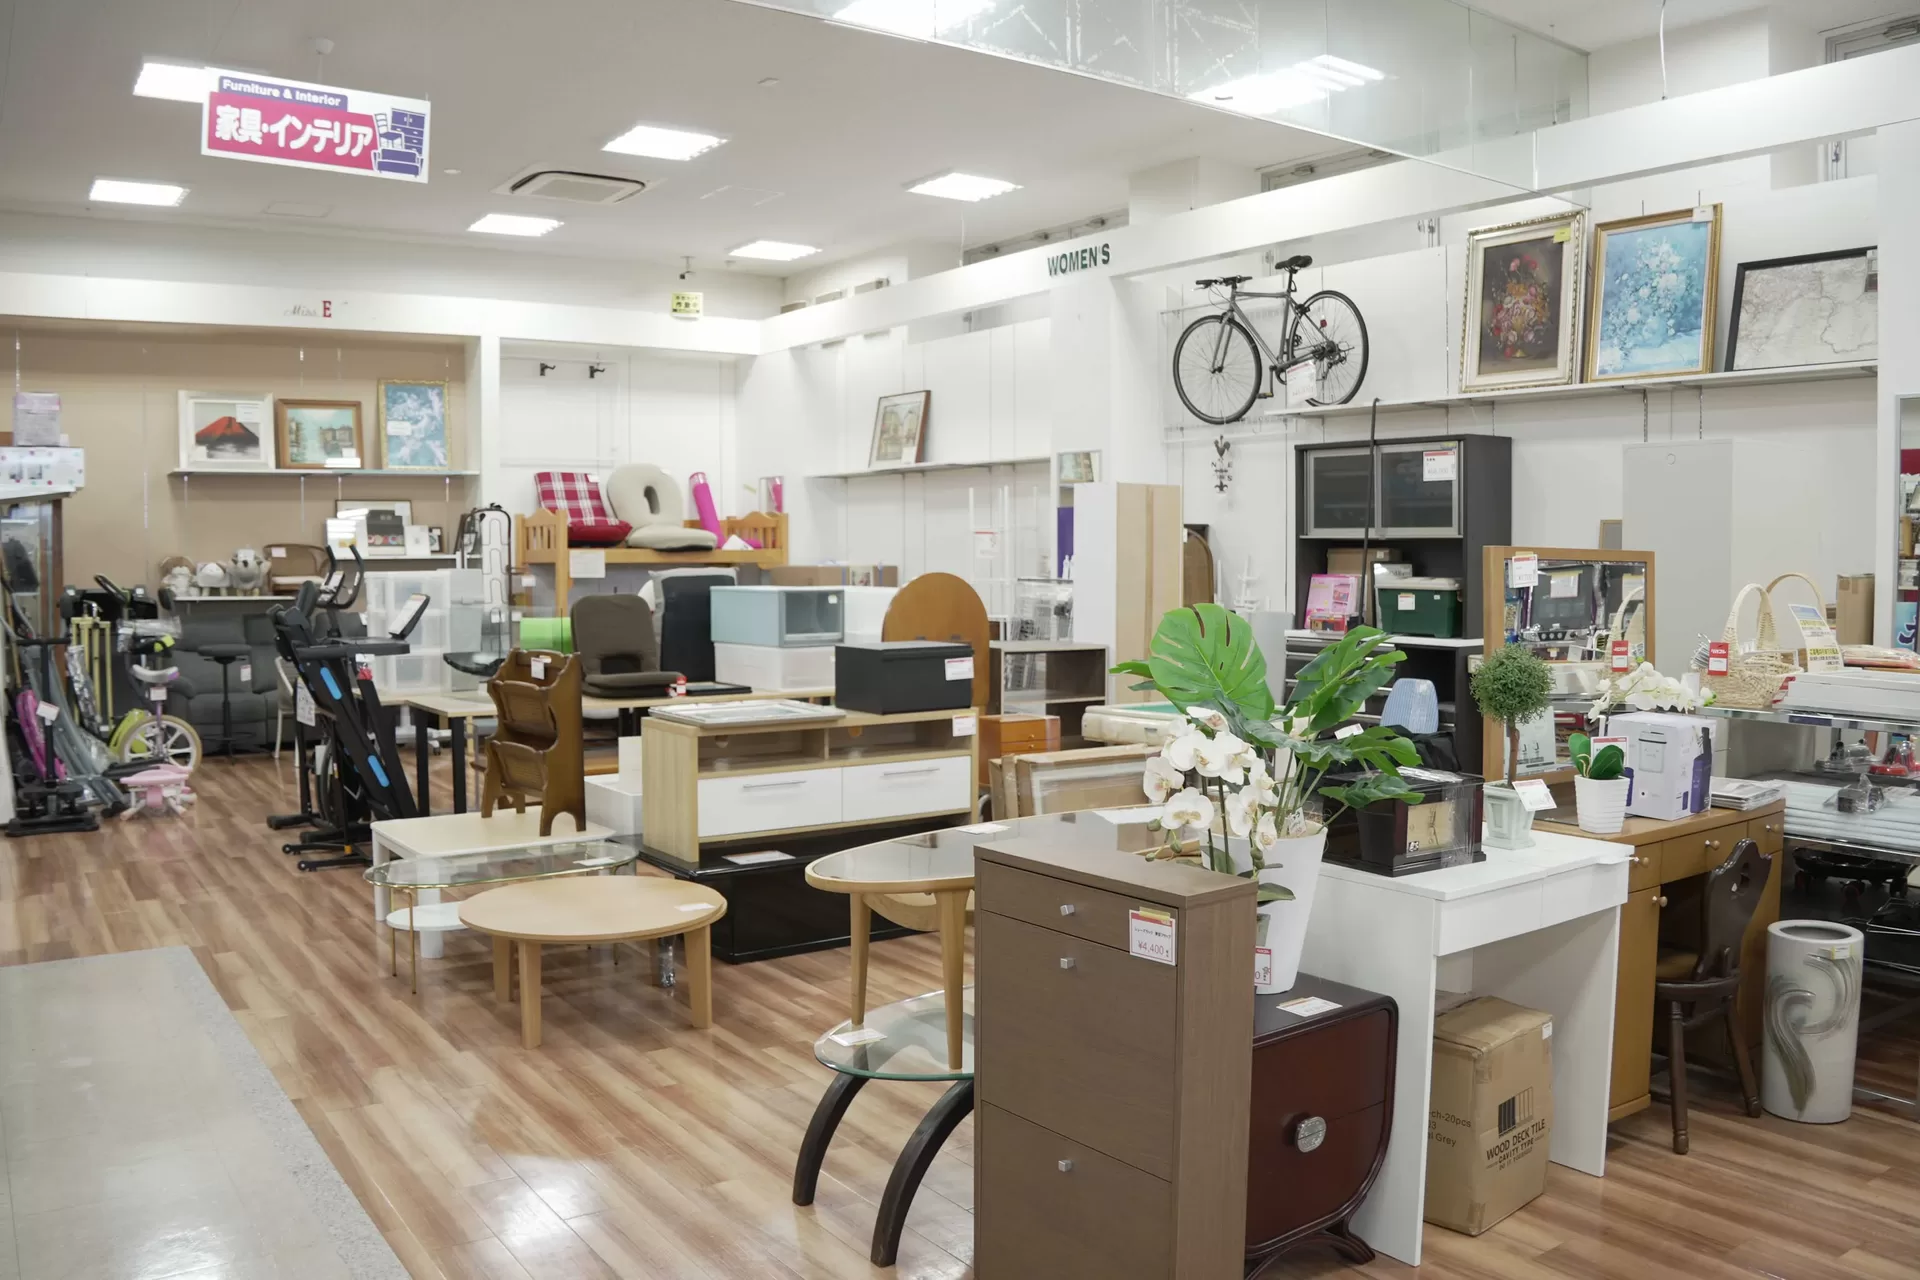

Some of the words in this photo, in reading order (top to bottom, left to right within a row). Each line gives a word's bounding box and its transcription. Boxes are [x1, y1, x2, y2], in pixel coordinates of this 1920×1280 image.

[222, 79, 280, 98] Furniture
[282, 89, 293, 100] &
[295, 90, 341, 107] Interior
[1047, 243, 1110, 276] WOMEN'S
[322, 300, 332, 318] E
[1138, 940, 1165, 955] ¥4,400
[1429, 1109, 1472, 1129] ch-20pcs
[1435, 1132, 1457, 1147] Grey
[1486, 1139, 1510, 1161] WOOD
[1512, 1127, 1530, 1146] DECK
[1530, 1118, 1545, 1136] TILE
[1498, 1146, 1519, 1164] CAVITY
[1520, 1137, 1534, 1151] TYPE
